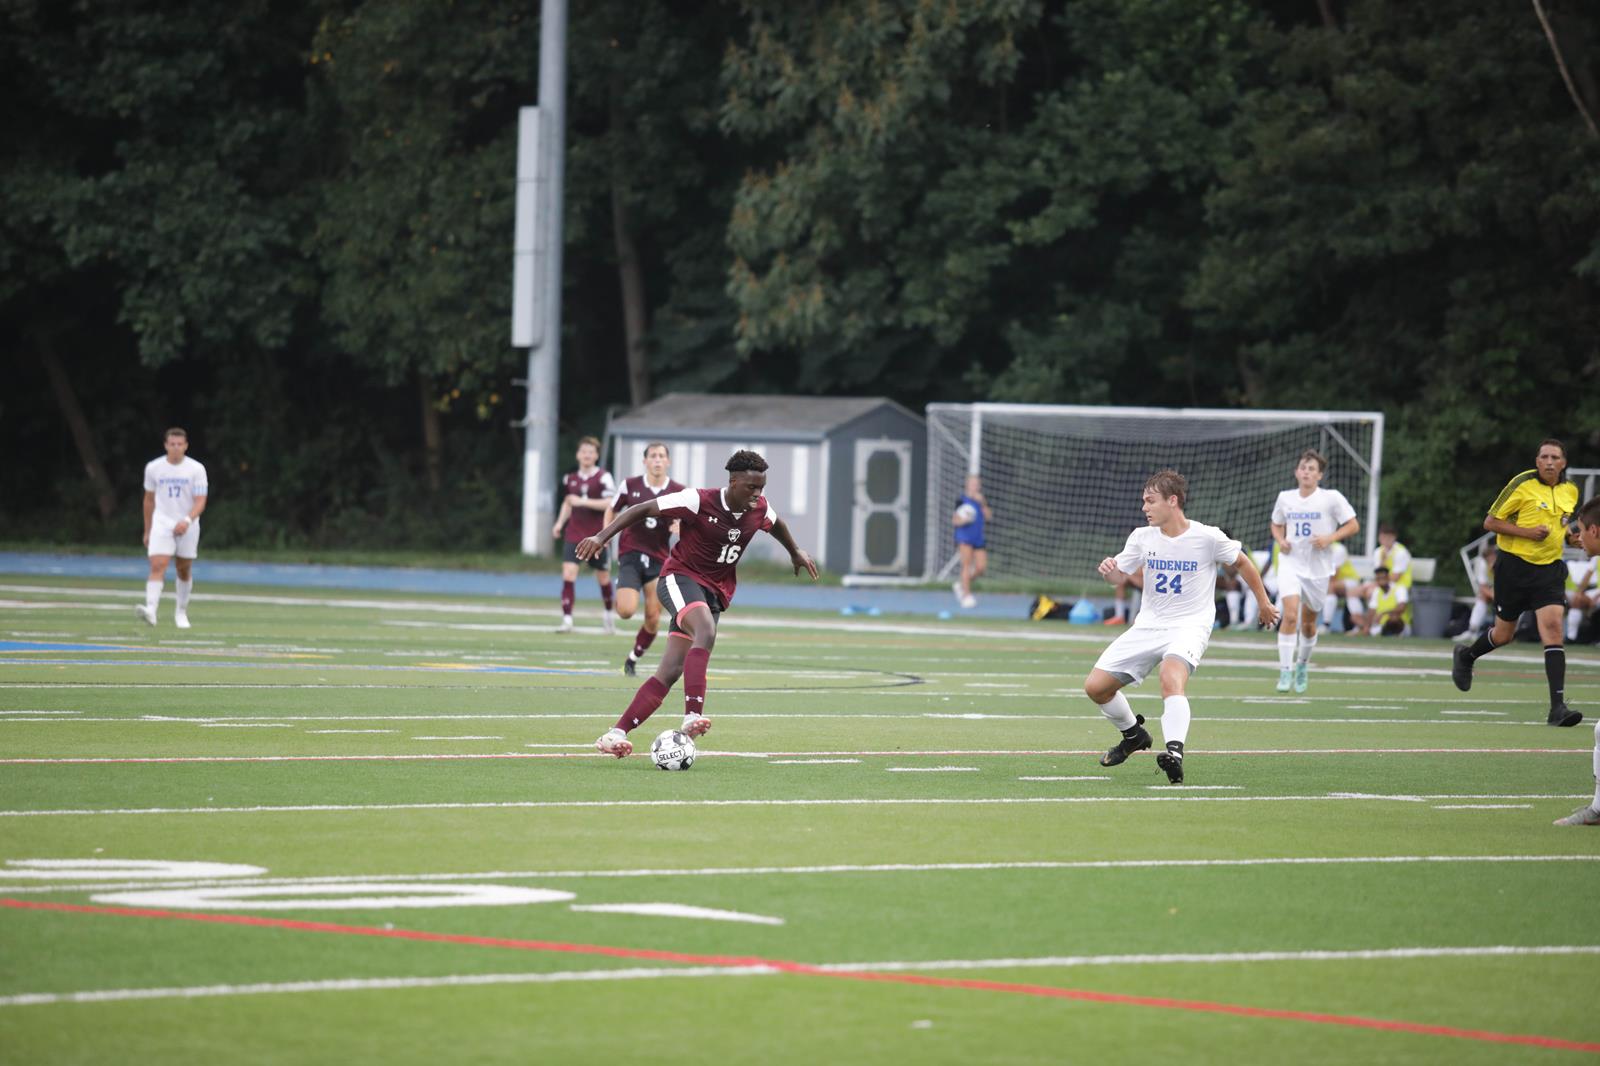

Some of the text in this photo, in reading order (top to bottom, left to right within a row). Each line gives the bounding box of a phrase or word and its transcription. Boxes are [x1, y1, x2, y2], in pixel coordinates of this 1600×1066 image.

[168, 486, 181, 498] 17
[1295, 522, 1311, 536] 16
[716, 544, 741, 564] 16
[1147, 559, 1198, 571] WIDENER
[1155, 573, 1182, 594] 24
[658, 749, 682, 762] SELECT
